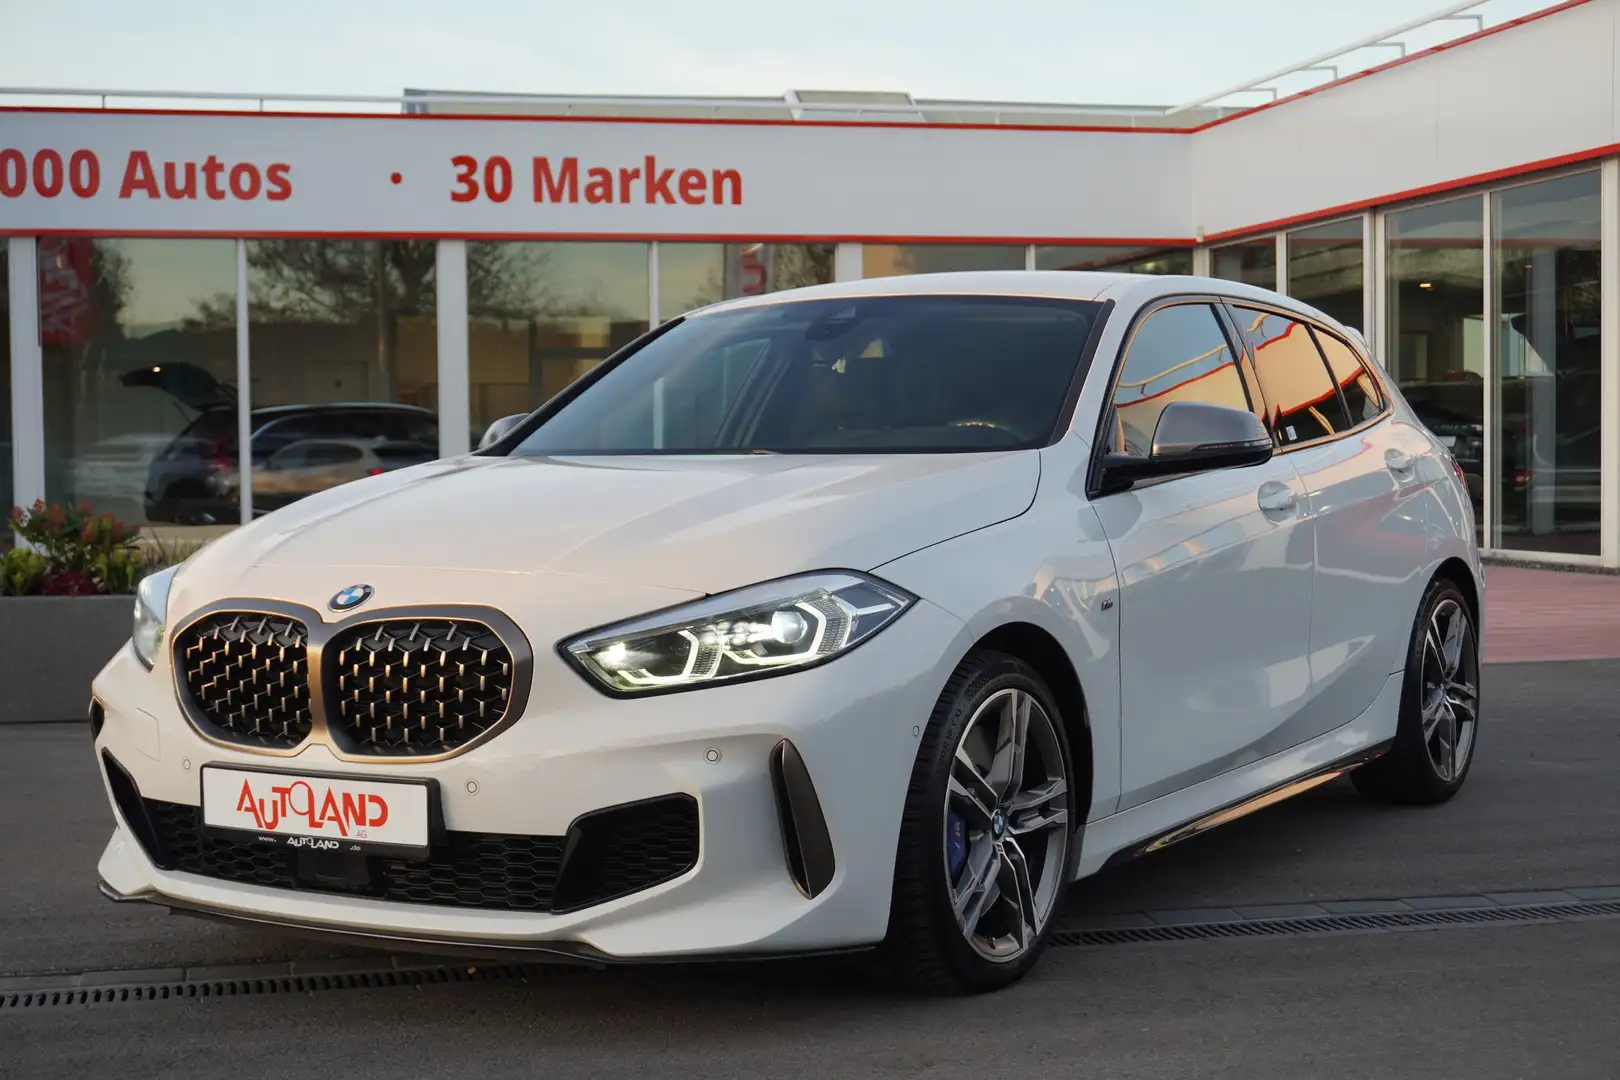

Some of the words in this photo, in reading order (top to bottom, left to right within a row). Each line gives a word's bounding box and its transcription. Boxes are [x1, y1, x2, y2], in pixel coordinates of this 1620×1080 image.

[119, 150, 292, 201] Autos
[450, 154, 513, 203] 30
[532, 155, 742, 206] Marken
[357, 830, 367, 838] AG
